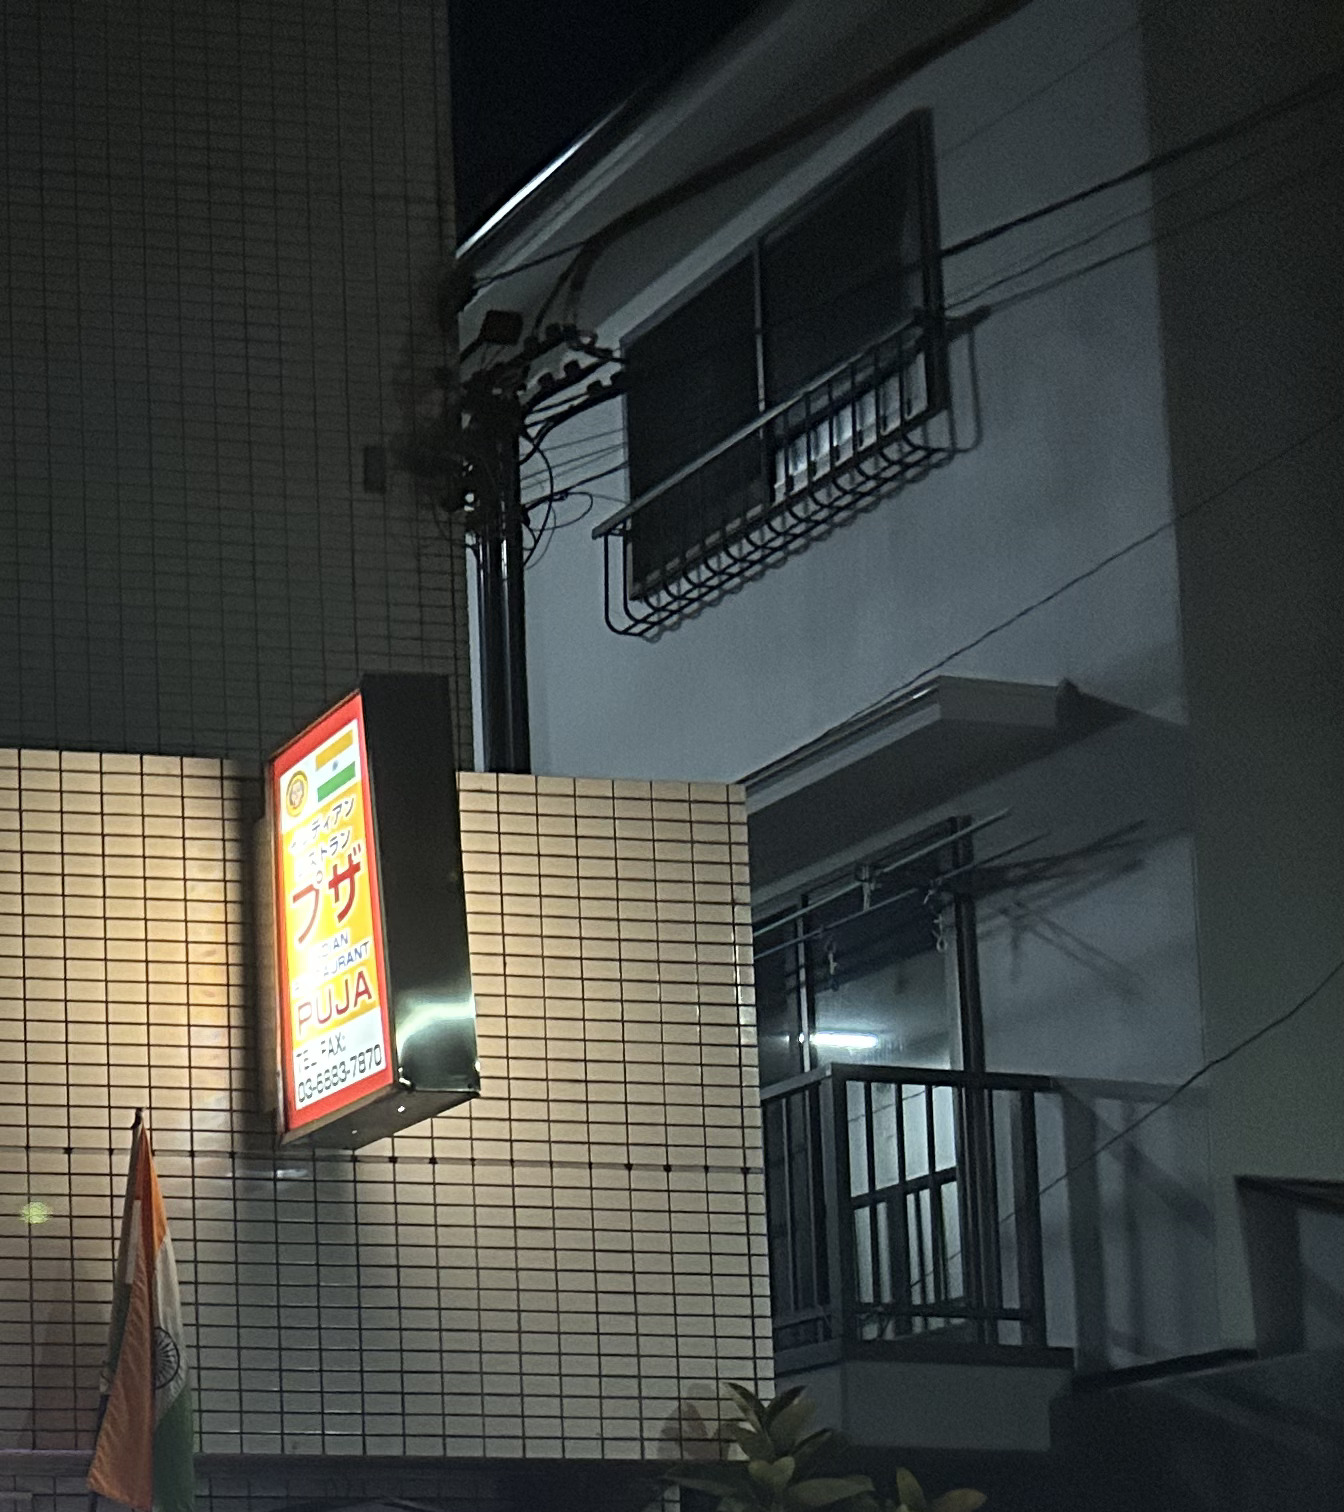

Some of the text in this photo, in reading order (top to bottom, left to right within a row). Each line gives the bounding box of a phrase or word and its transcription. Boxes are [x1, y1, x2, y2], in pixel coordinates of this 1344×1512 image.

[293, 843, 362, 944] プザ
[298, 971, 372, 1036] PUJA
[297, 1043, 383, 1102] 03-6883-7870
